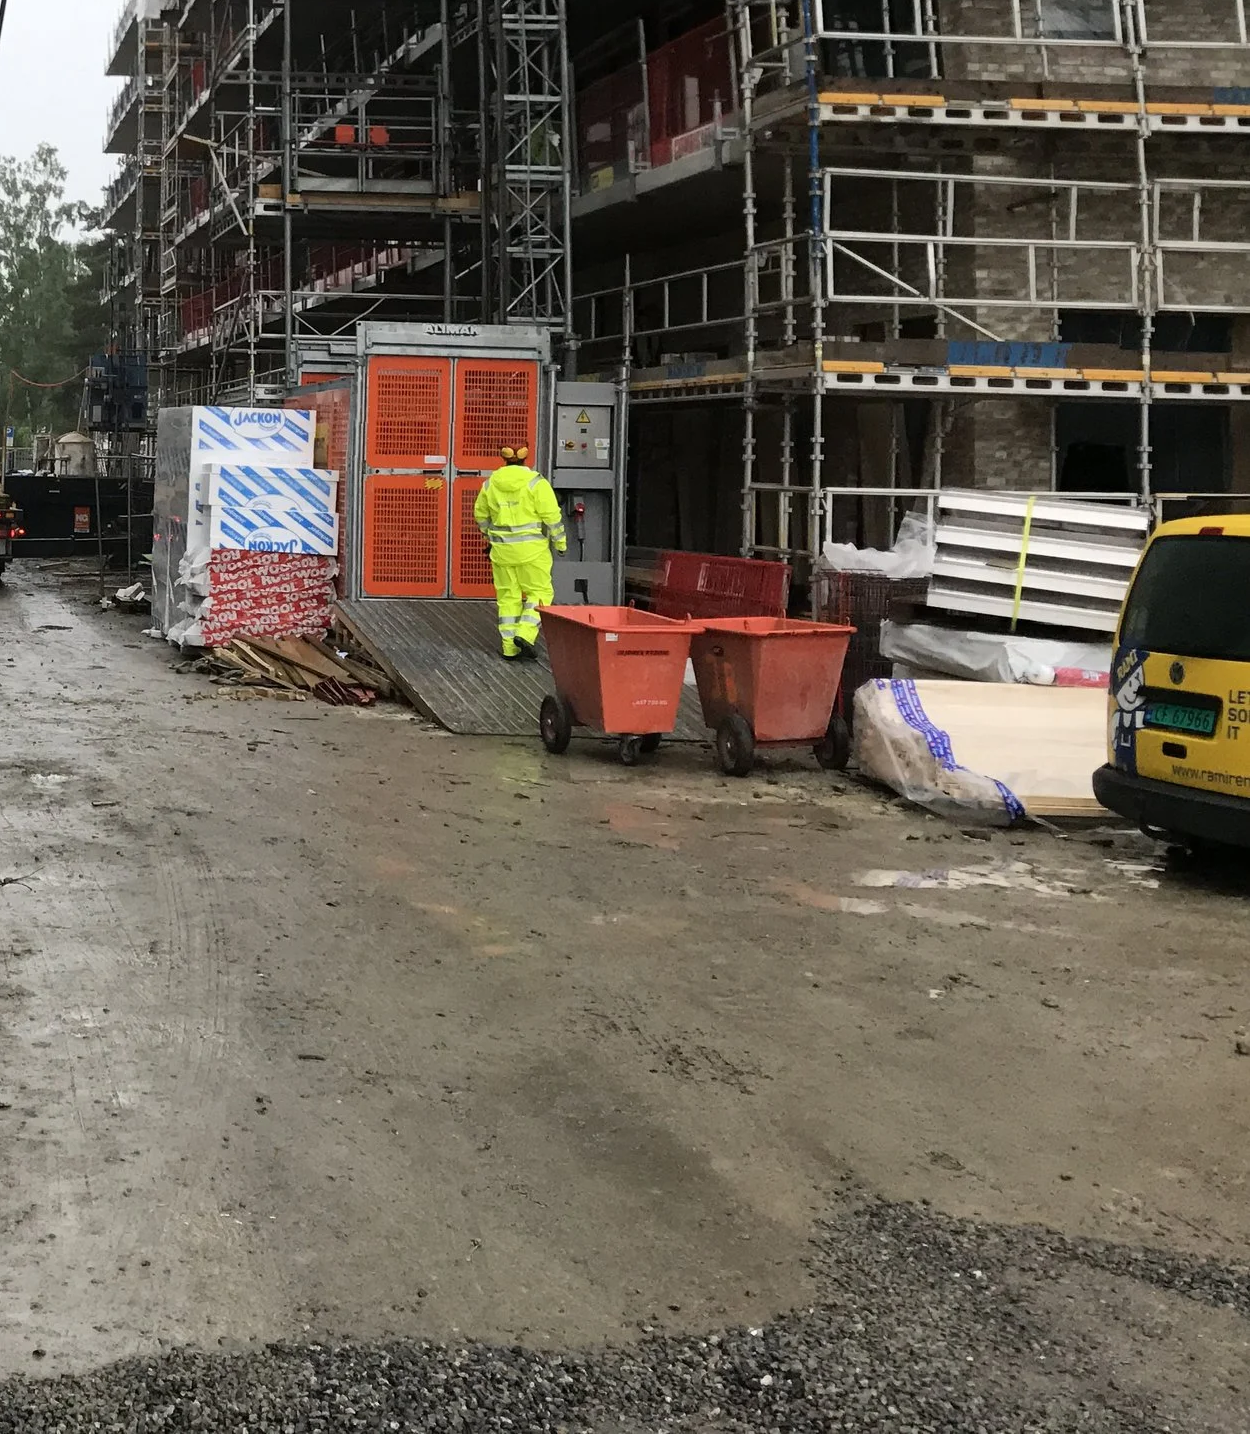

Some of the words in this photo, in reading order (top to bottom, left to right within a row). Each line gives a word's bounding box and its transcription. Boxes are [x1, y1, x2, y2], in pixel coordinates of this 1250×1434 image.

[425, 323, 480, 336] ALIMAK
[234, 411, 281, 426] JACKON
[1173, 709, 1210, 730] 67966
[1227, 726, 1240, 740] IT
